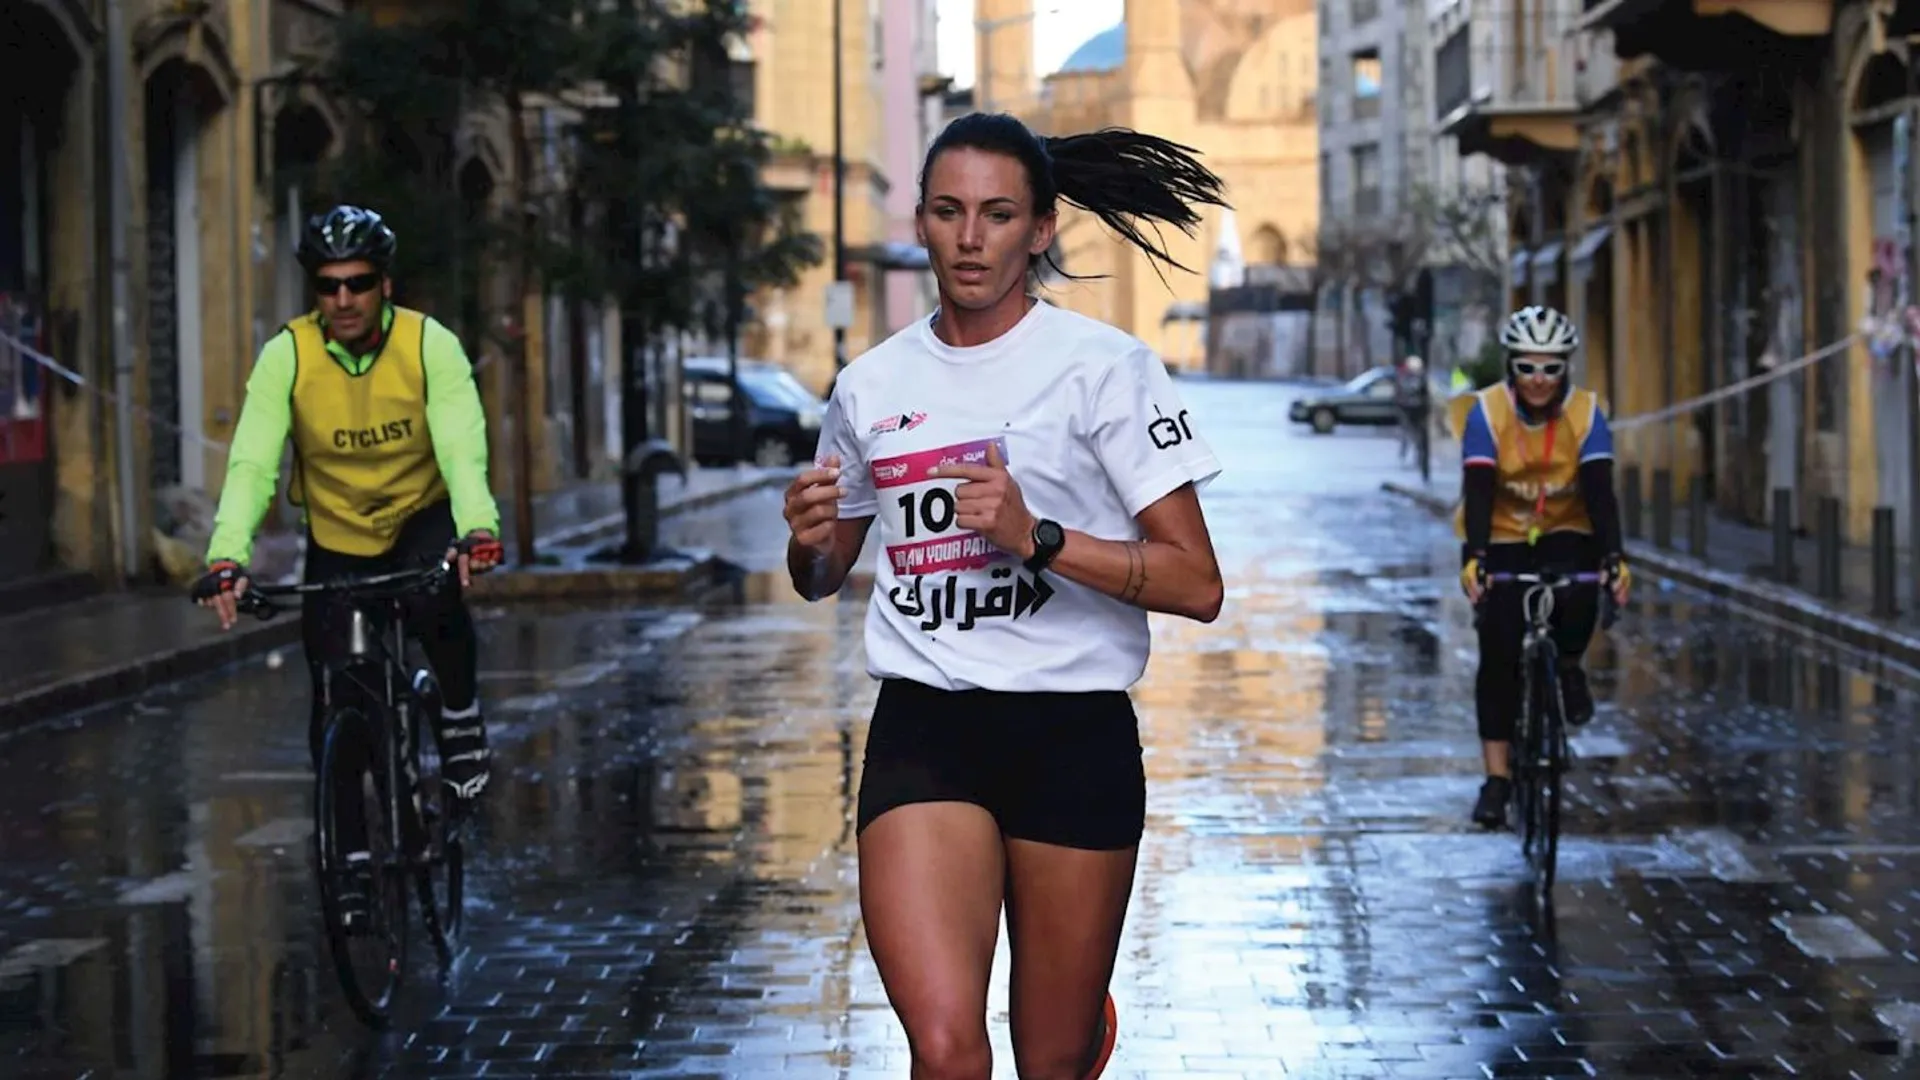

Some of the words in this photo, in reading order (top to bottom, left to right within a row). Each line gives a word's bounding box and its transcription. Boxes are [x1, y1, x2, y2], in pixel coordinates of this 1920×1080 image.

[333, 418, 412, 448] CYCLIST
[926, 541, 961, 564] YOUR
[889, 567, 1013, 631] قرارك
